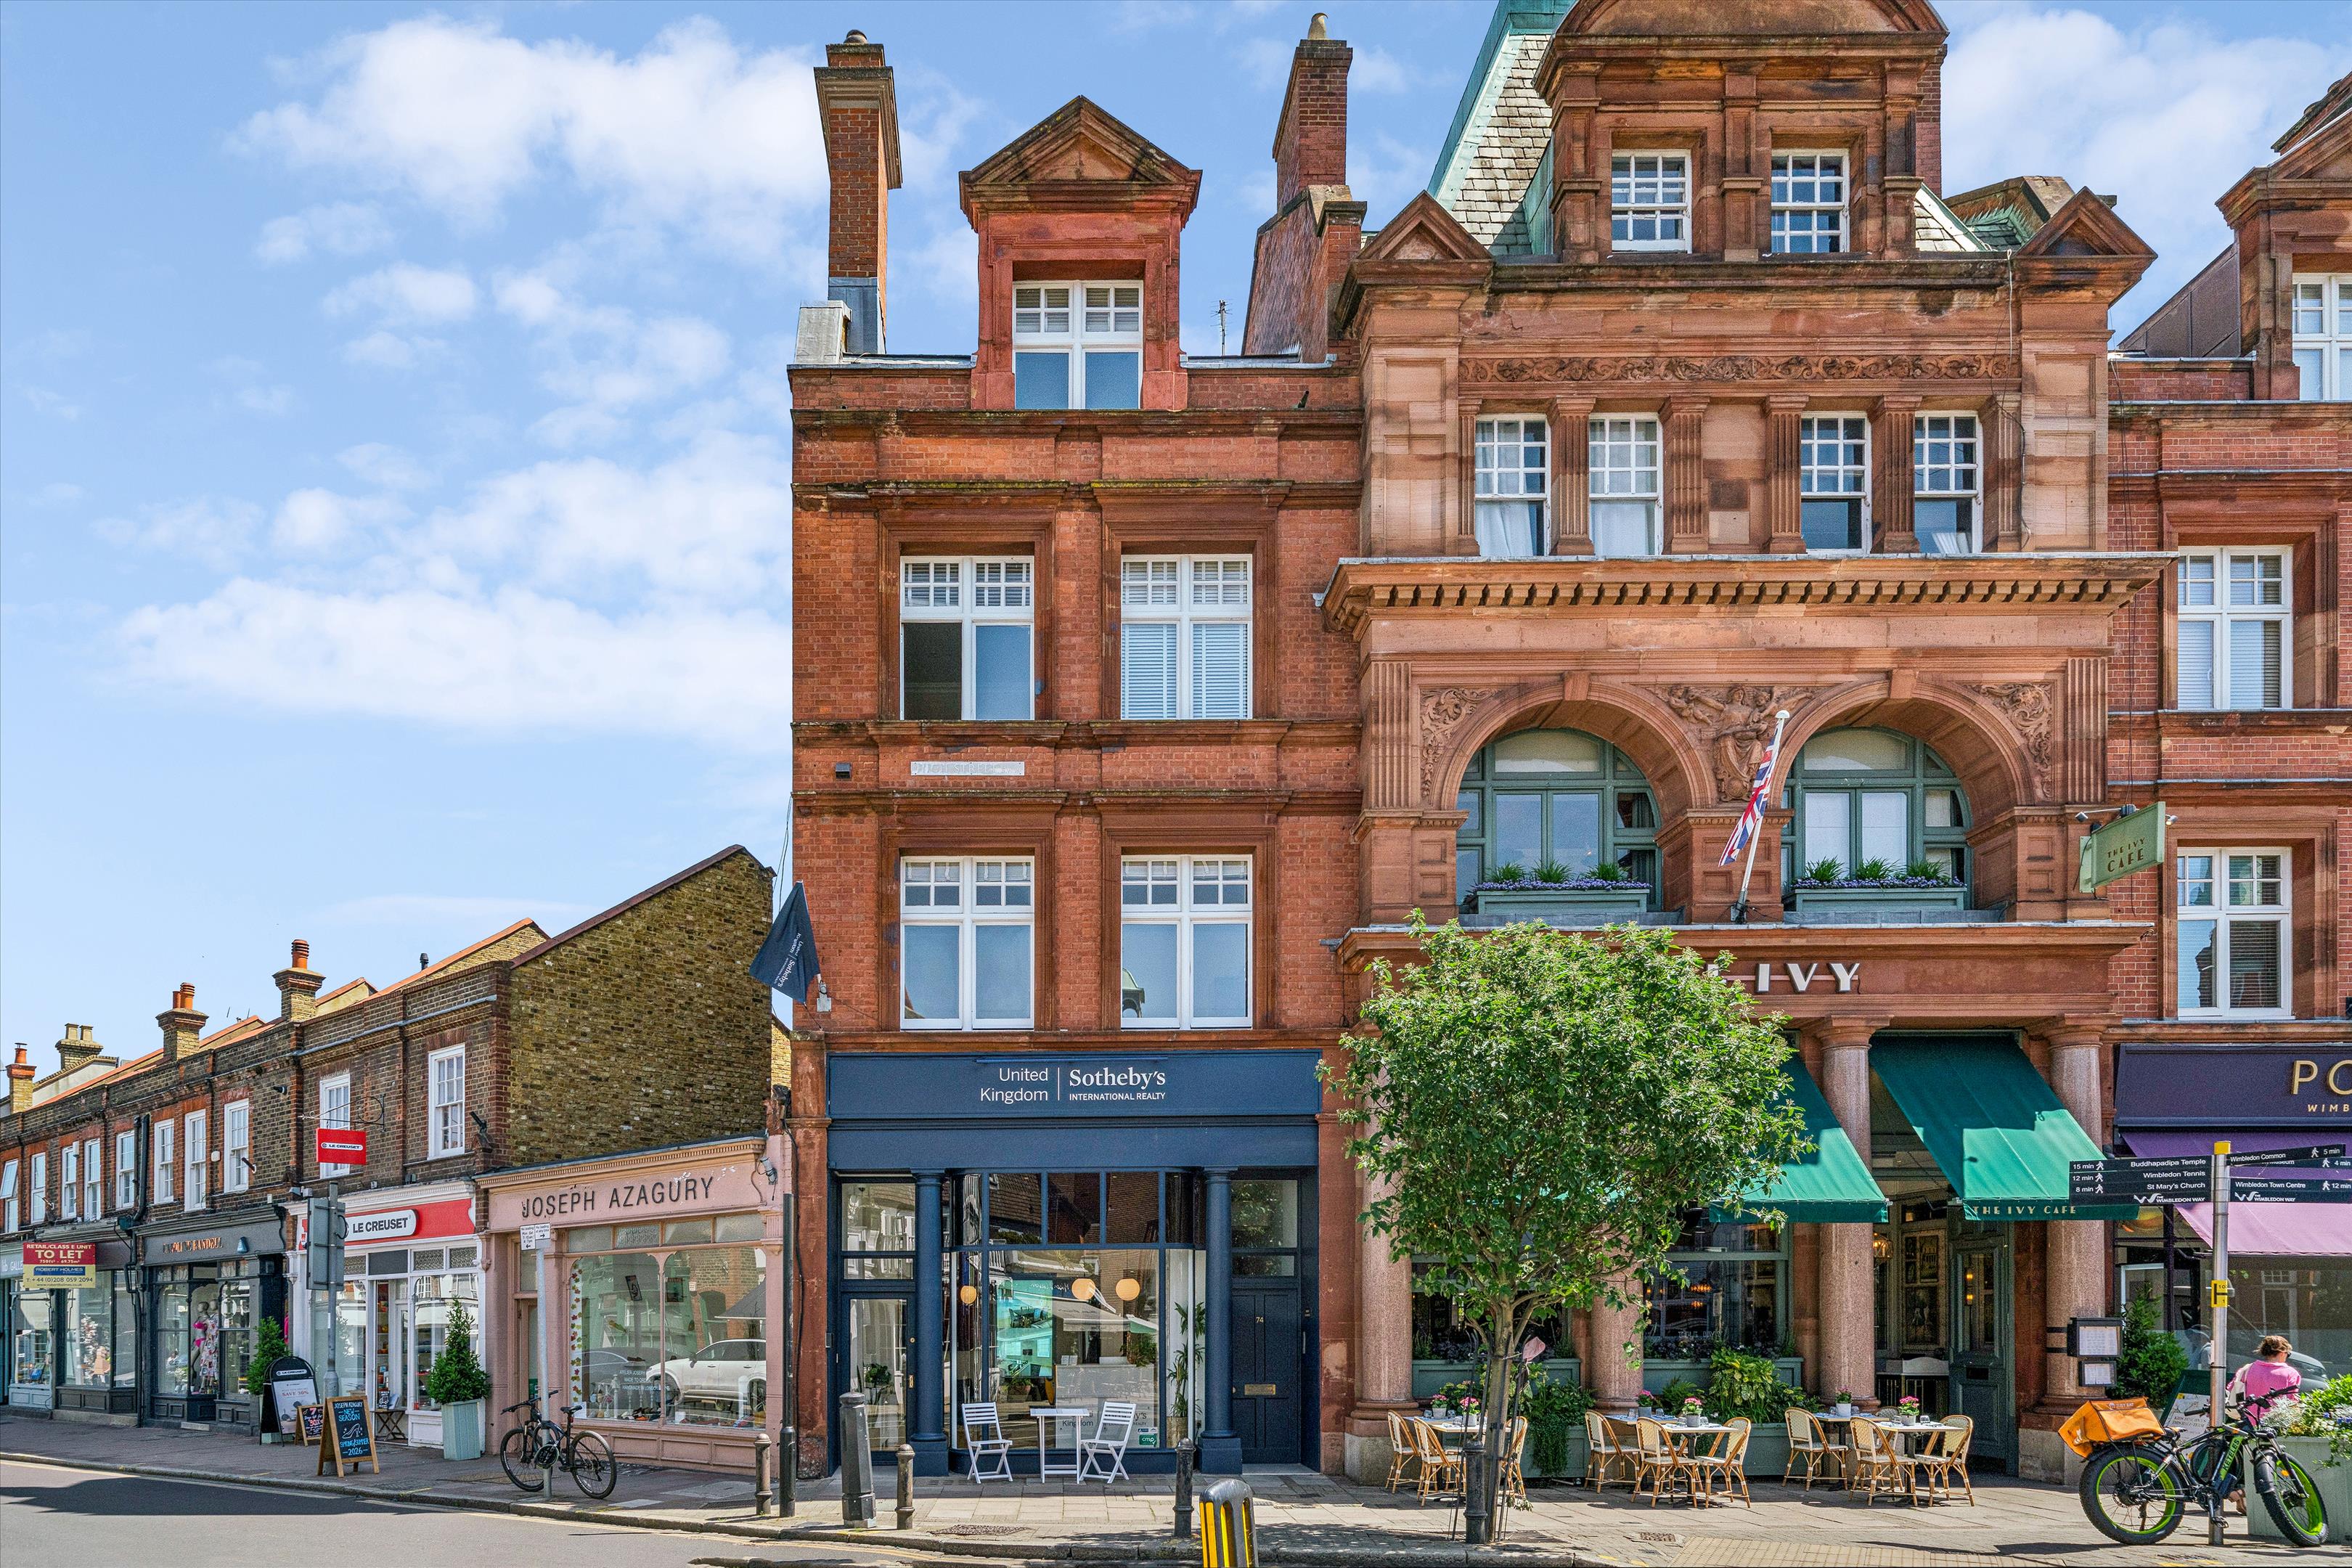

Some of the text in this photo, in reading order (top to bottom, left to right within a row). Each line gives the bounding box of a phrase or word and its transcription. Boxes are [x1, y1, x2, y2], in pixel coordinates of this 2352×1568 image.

[2107, 837, 2145, 858] THE IVY
[777, 959, 796, 989] Sotheby's
[1757, 963, 1861, 992] IVY
[999, 1068, 1048, 1082] United
[1069, 1067, 1166, 1090] Sotheby's
[2292, 1060, 2352, 1095] PO
[980, 1087, 1048, 1104] Kingdom
[2308, 1103, 2350, 1112] WIMB
[521, 1176, 714, 1218] JOSEPH AZAGURY
[1973, 1206, 2076, 1214] THE IVY CAFE
[353, 1217, 408, 1233] LE CREUSET
[35, 1250, 84, 1259] TO LET
[340, 1437, 369, 1447] SPRING/SUMMER
[2223, 1439, 2239, 1471] KETELES
